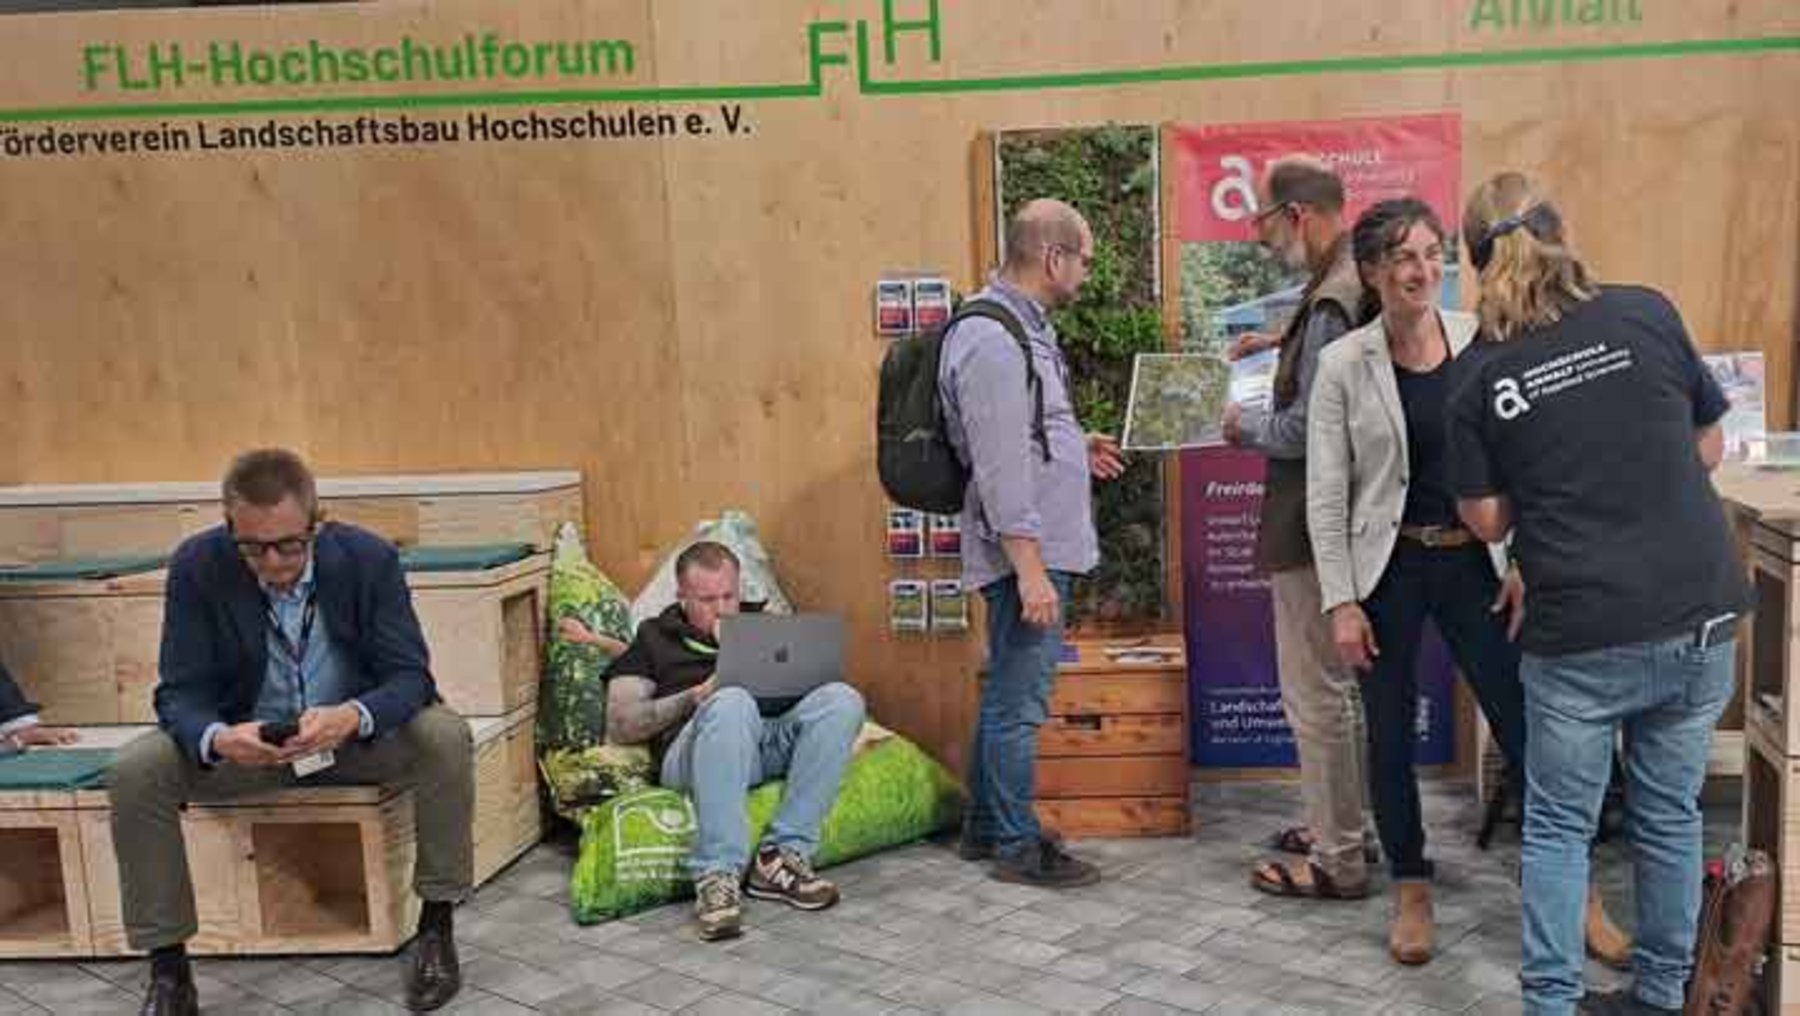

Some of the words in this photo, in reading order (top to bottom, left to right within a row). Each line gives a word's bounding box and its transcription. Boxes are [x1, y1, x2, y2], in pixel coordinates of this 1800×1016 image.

[82, 34, 636, 91] FLH-Hochschulforum
[0, 122, 190, 156] örderverein
[199, 116, 460, 151] Landschaftsbau
[468, 109, 677, 143] Hochschulen
[684, 112, 712, 135] e.
[721, 104, 751, 137] V.
[1525, 365, 1574, 389] ANHALT
[1210, 699, 1283, 714] Landschaf
